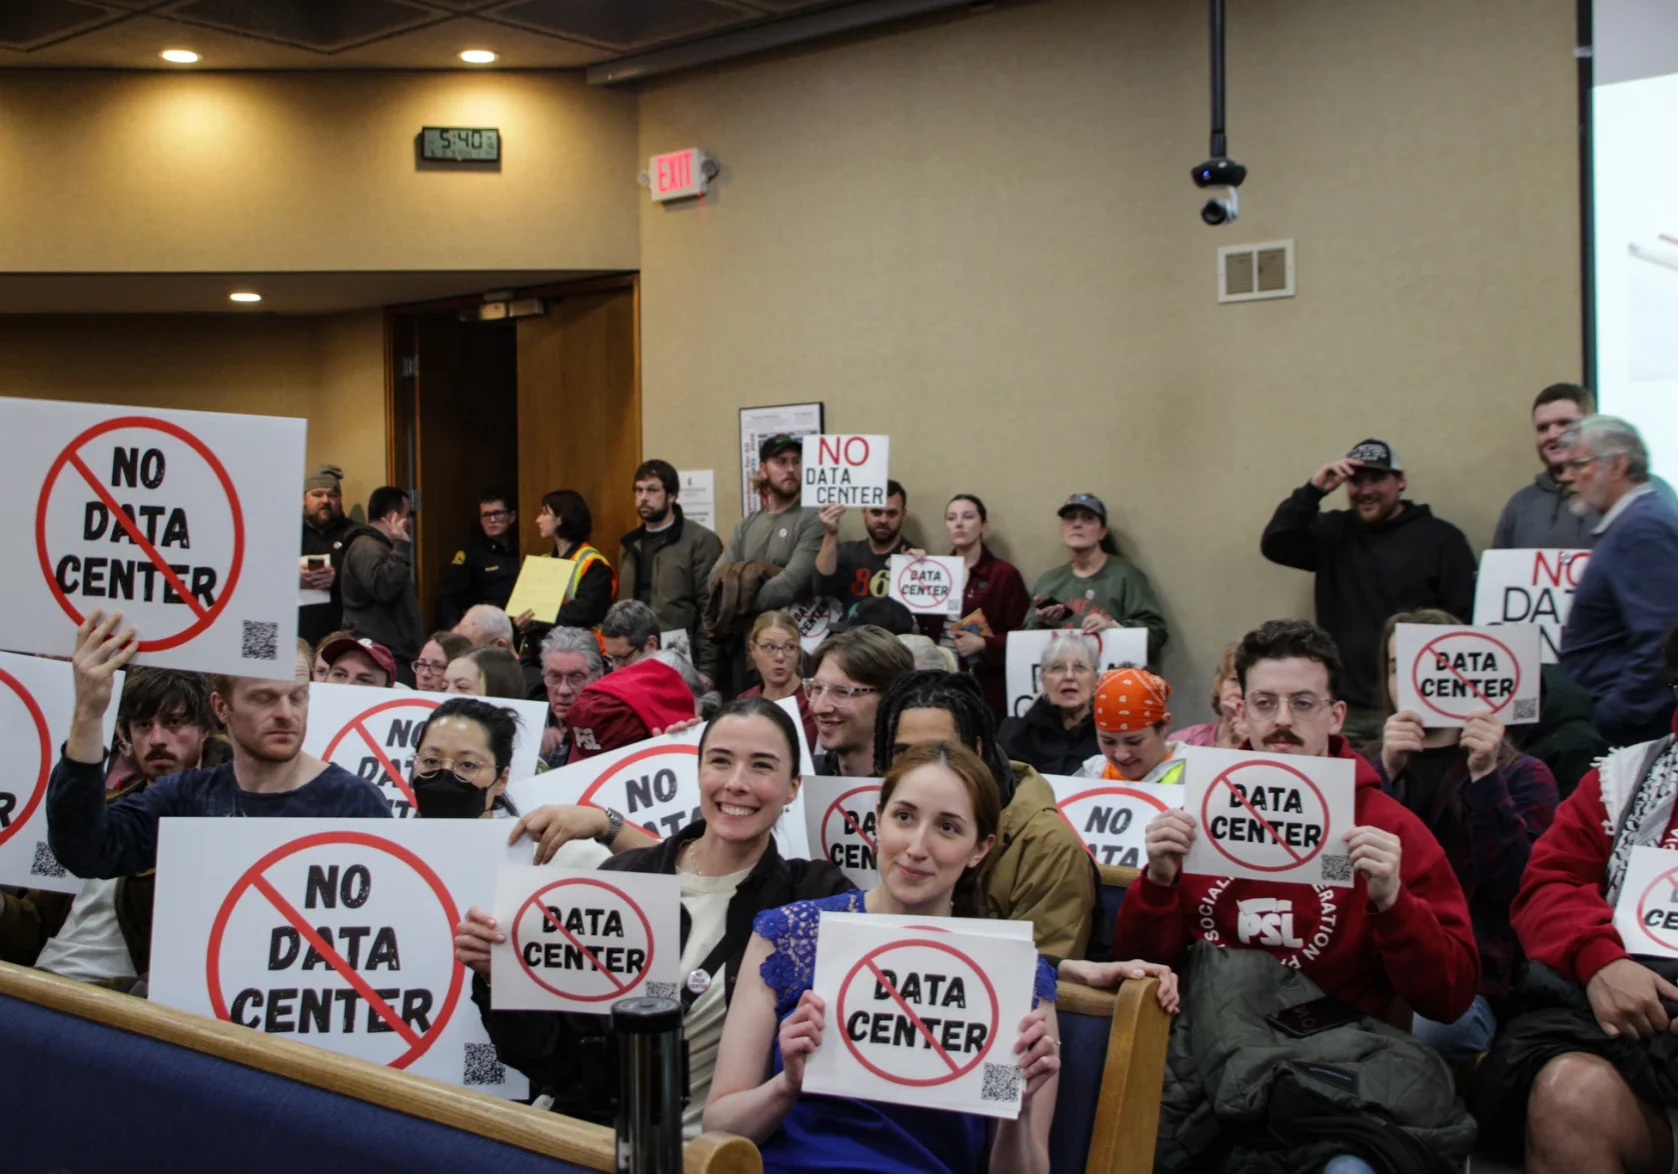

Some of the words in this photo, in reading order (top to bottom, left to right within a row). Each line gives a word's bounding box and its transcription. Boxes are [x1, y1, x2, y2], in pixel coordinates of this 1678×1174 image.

[440, 129, 482, 149] 5:40
[657, 150, 692, 192] EXIT
[818, 436, 869, 466] NO
[111, 446, 166, 490] NO
[806, 468, 851, 485] DATA
[817, 486, 884, 504] CENTER
[83, 501, 190, 549] DATA
[56, 555, 217, 607] CENTER
[902, 584, 949, 596] CENTER
[910, 570, 941, 581] DATA
[1503, 587, 1576, 624] DA
[1435, 652, 1497, 672] DATA
[1421, 678, 1514, 698] CENTER
[357, 756, 415, 788] DAT
[625, 768, 678, 813] NO
[1229, 783, 1303, 814] DATA
[844, 811, 877, 836] DA
[1084, 806, 1133, 835] NO
[1211, 816, 1322, 848] CENTER
[830, 843, 877, 870] CEN
[1088, 843, 1139, 867] TA
[304, 864, 371, 909] NO
[542, 905, 625, 938] DATA
[1198, 876, 1235, 942] SOCIAL
[1302, 884, 1337, 960] ERATION
[1237, 911, 1304, 949] PSL
[268, 926, 401, 971] DATA
[523, 942, 646, 974] CENTER
[873, 969, 966, 1009] DATA
[230, 988, 434, 1033] CENTER
[847, 1010, 988, 1053] CENTER
